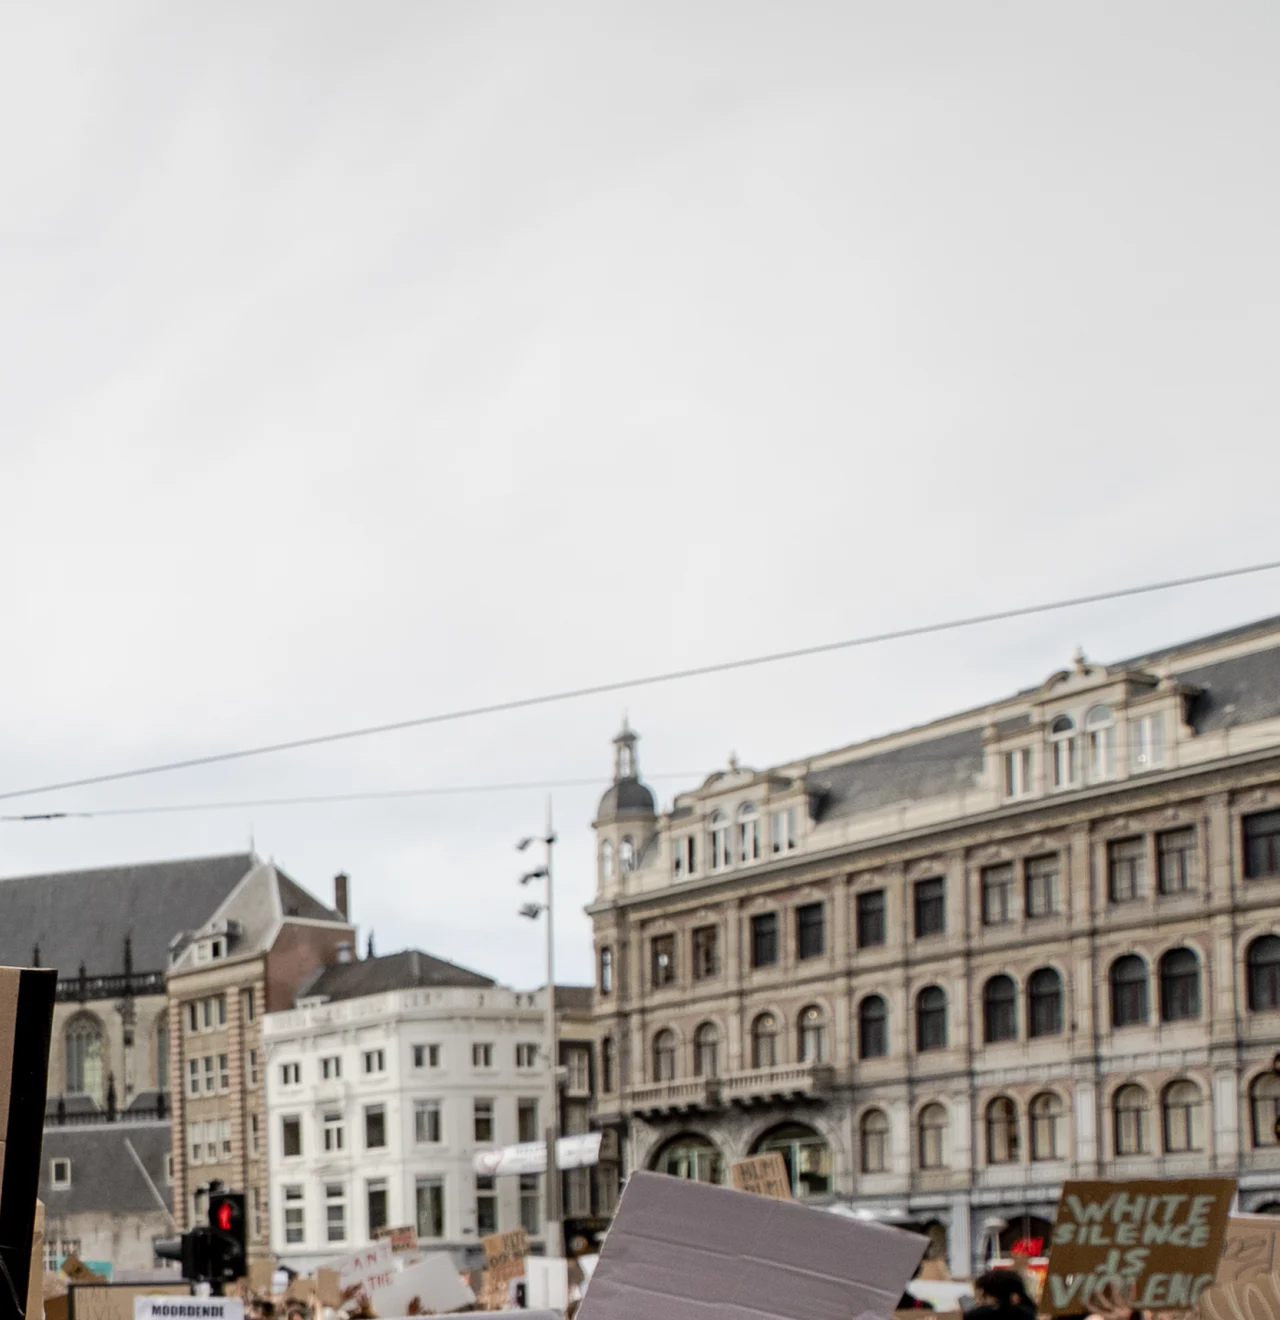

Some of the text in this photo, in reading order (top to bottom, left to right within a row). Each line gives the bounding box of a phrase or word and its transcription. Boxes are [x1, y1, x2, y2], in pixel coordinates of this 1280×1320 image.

[1066, 1192, 1216, 1226] WHITE
[1054, 1222, 1211, 1248] SILENCE
[1096, 1247, 1151, 1277] IS
[151, 1304, 224, 1318] MOORDENDE
